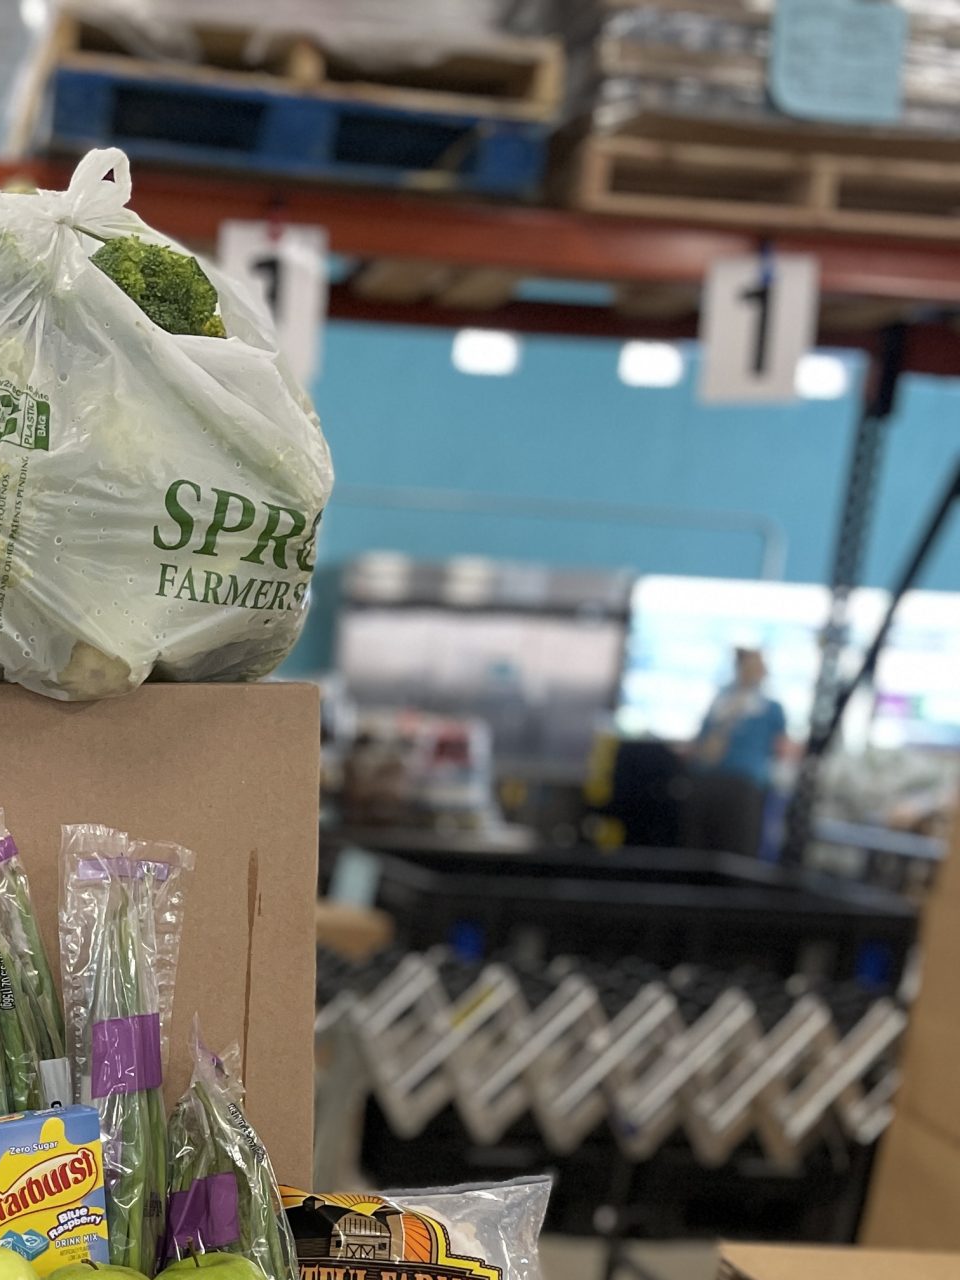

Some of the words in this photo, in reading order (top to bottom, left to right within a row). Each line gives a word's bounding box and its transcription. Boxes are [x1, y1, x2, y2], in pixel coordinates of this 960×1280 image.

[737, 285, 771, 376] 1
[24, 401, 36, 446] PLASTIC
[36, 415, 47, 437] BAG
[9, 501, 22, 540] PATENTS
[16, 456, 29, 498] PENDING
[155, 562, 308, 611] FARMERS
[9, 1146, 31, 1155] Zero
[32, 1141, 58, 1153] Sugar
[49, 1214, 102, 1240] Raspberry
[58, 1207, 88, 1223] Blue
[55, 1236, 80, 1248] DRINK
[83, 1233, 98, 1243] MIX
